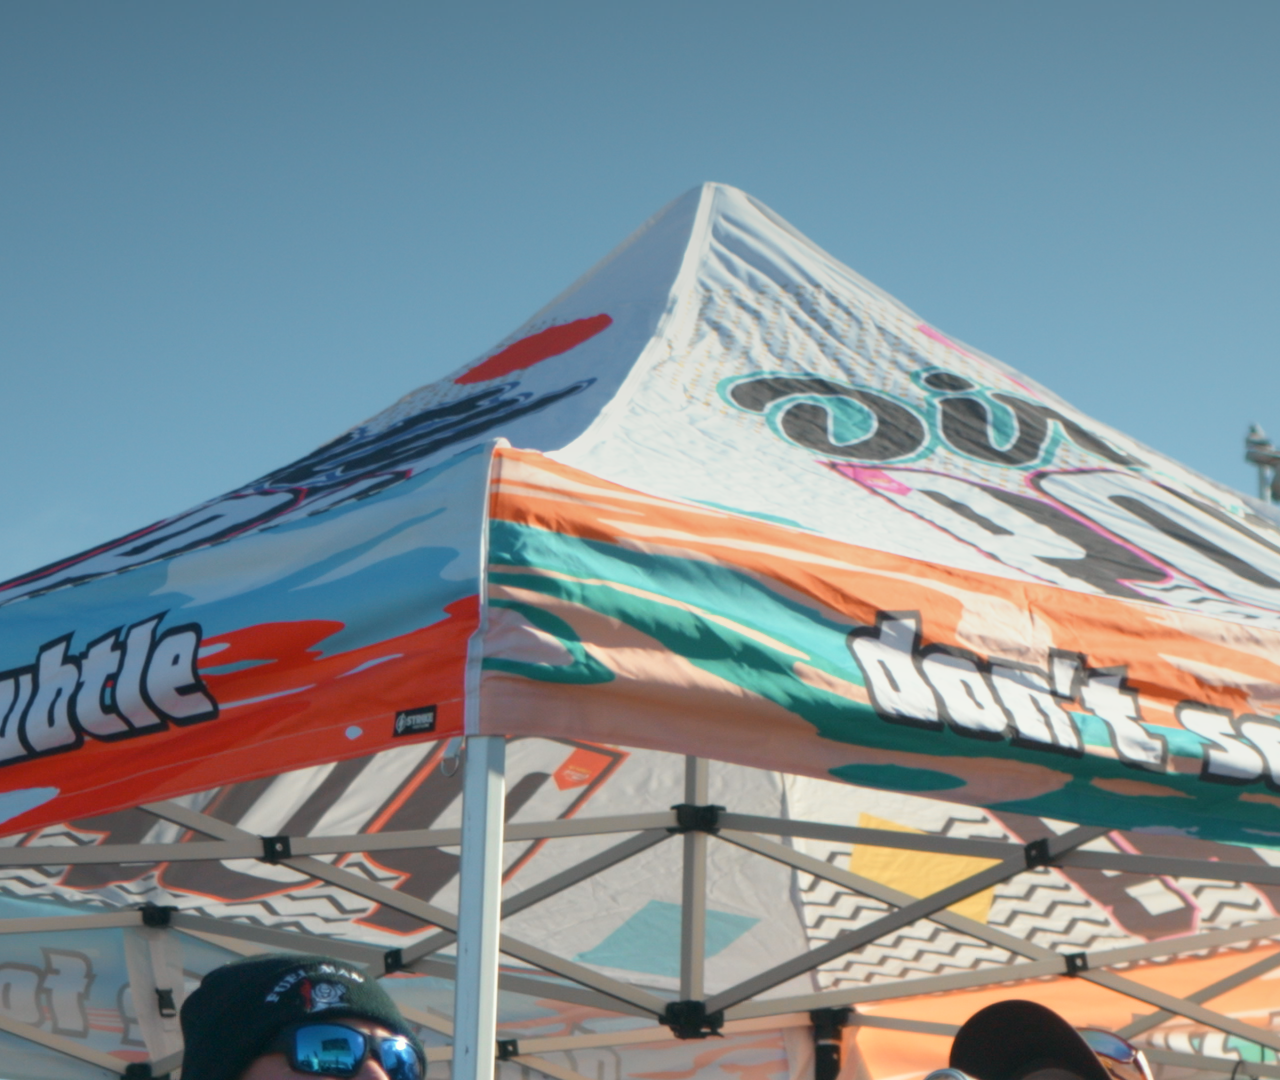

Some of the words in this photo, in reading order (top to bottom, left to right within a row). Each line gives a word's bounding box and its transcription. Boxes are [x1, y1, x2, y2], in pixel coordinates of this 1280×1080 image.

[845, 609, 1168, 773] don't
[265, 969, 307, 1004] FUEL
[319, 963, 365, 983] MAN
